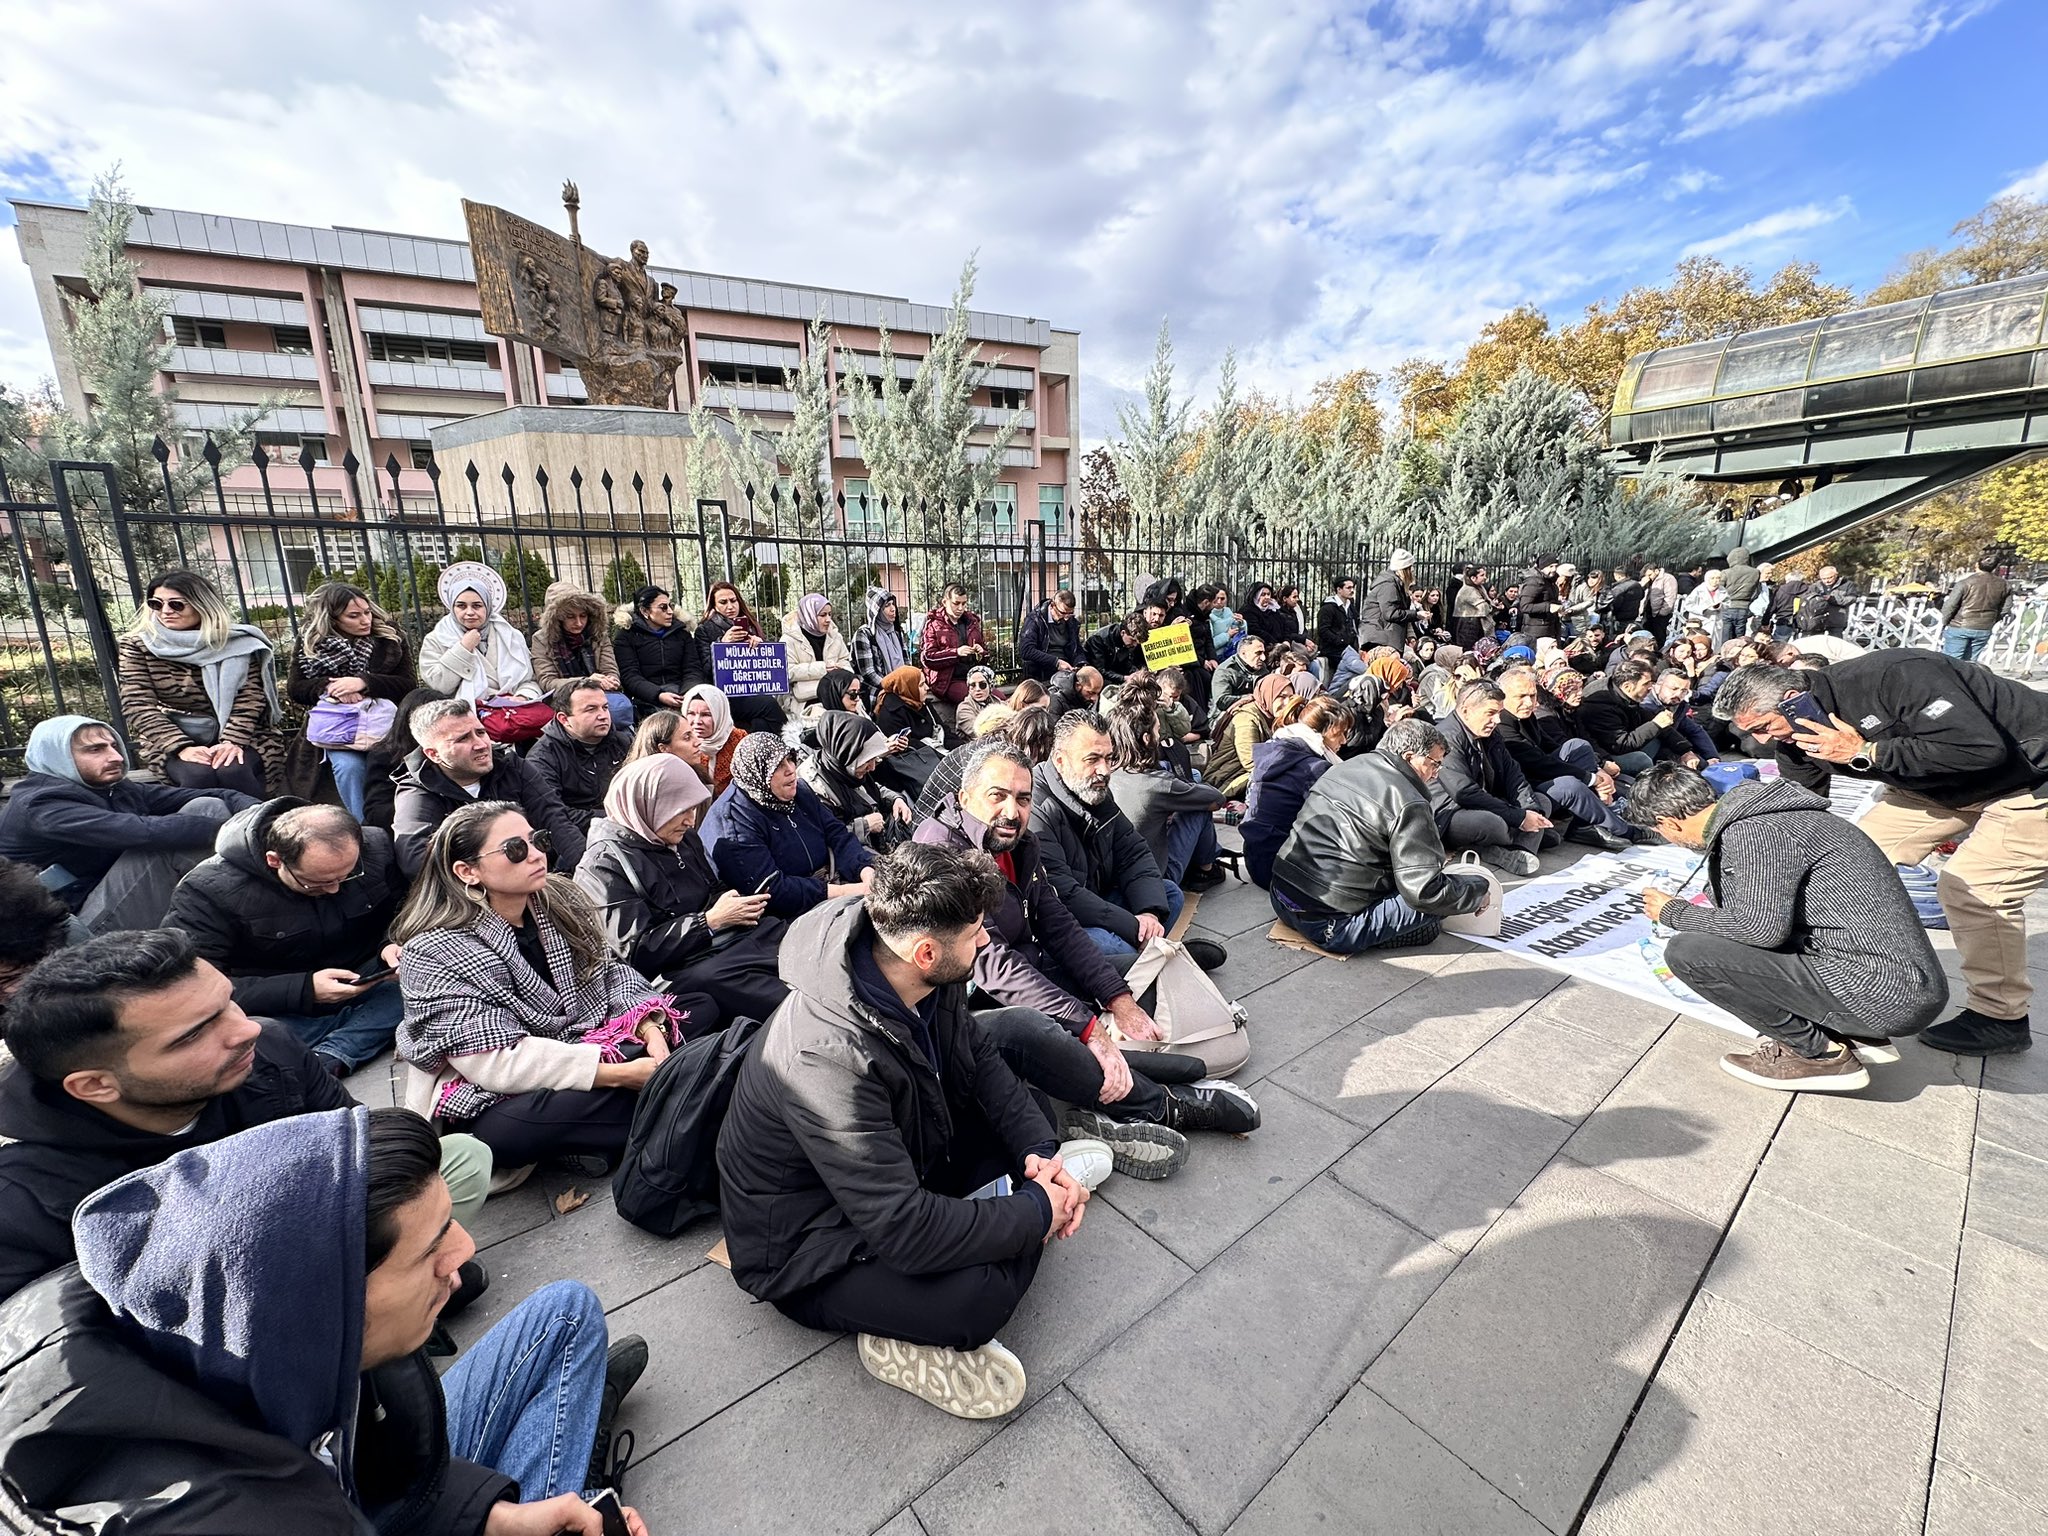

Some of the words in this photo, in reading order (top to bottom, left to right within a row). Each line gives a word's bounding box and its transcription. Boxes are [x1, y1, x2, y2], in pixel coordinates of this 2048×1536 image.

[726, 646, 759, 657] MÜLAKAT
[760, 645, 775, 657] GİBİ
[717, 658, 751, 670] MÜLAKAT
[753, 657, 784, 670] DEDİLER,
[733, 670, 771, 682] ÖĞRETMEN
[723, 683, 748, 695] KIYIMI
[749, 682, 784, 693] YAPTILAR.
[1527, 919, 1613, 958] Atama
